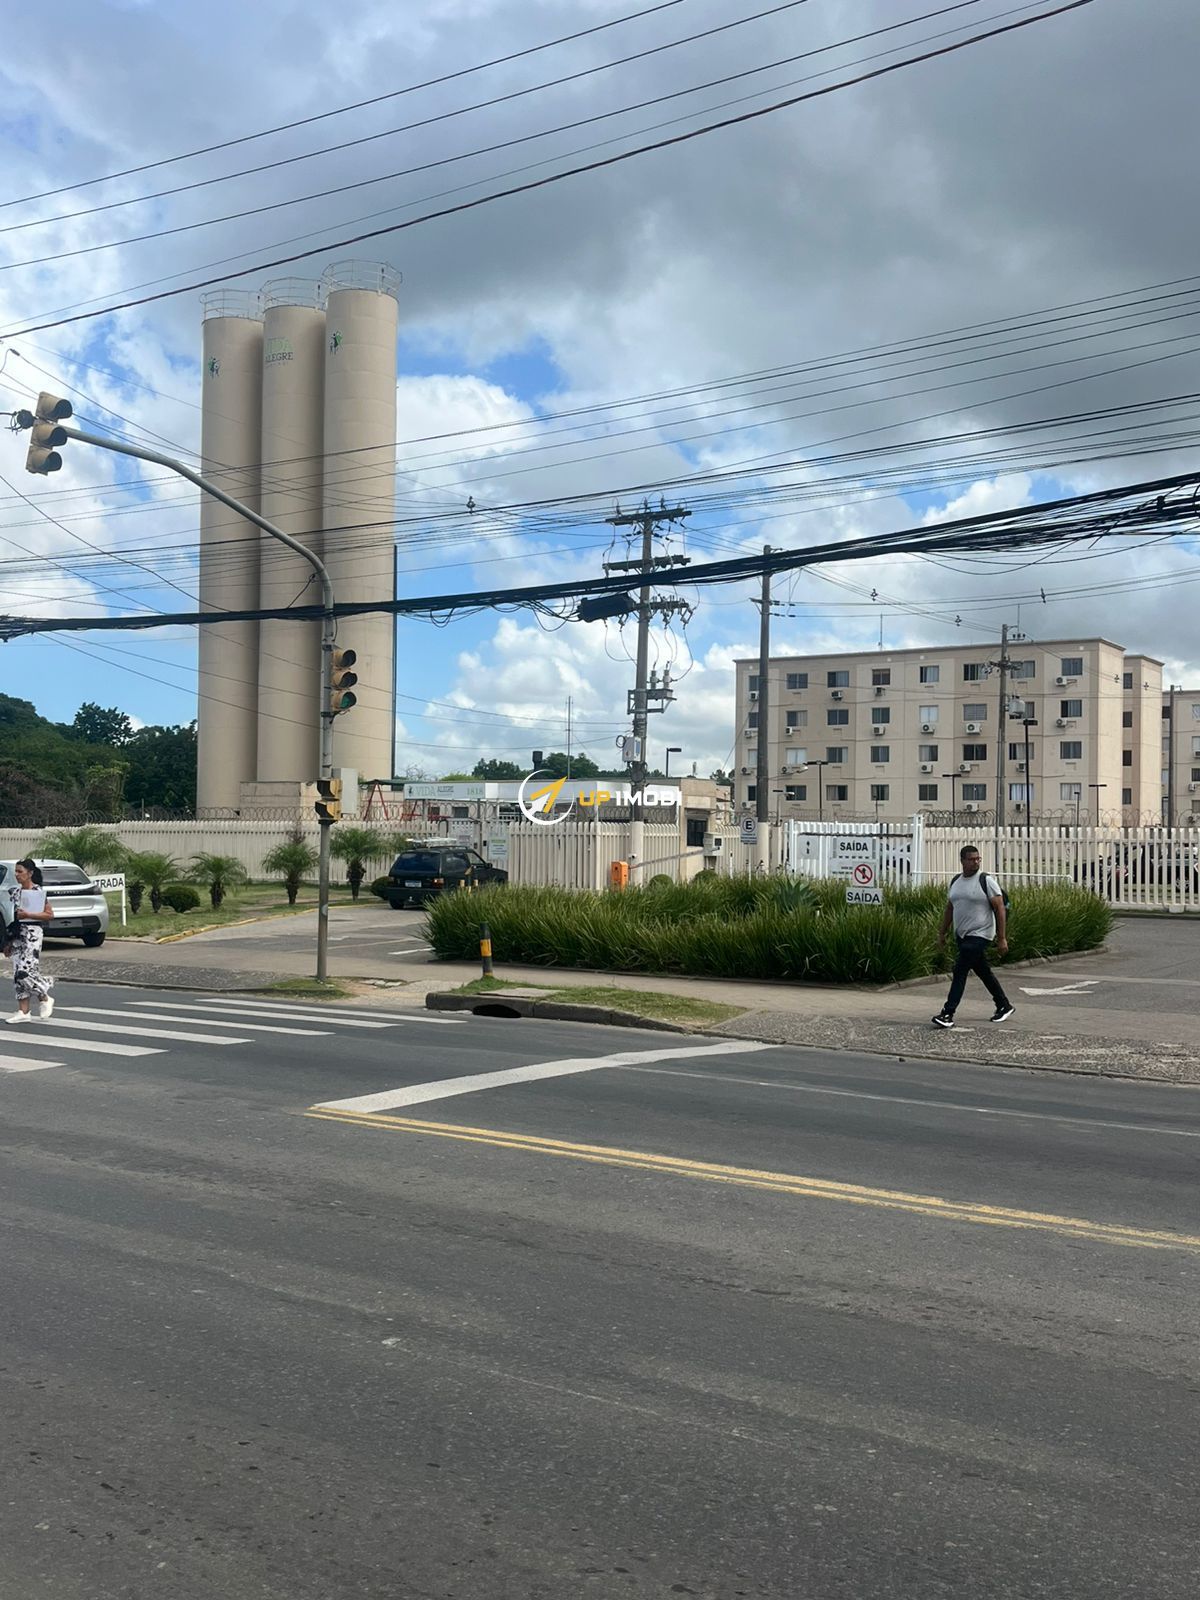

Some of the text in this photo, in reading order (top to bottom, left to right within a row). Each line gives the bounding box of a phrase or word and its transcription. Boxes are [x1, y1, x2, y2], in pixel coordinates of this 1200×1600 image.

[746, 820, 752, 830] E
[839, 840, 869, 852] SAÍDA
[93, 877, 124, 889] TRADA
[847, 889, 880, 903] SAÍDA
